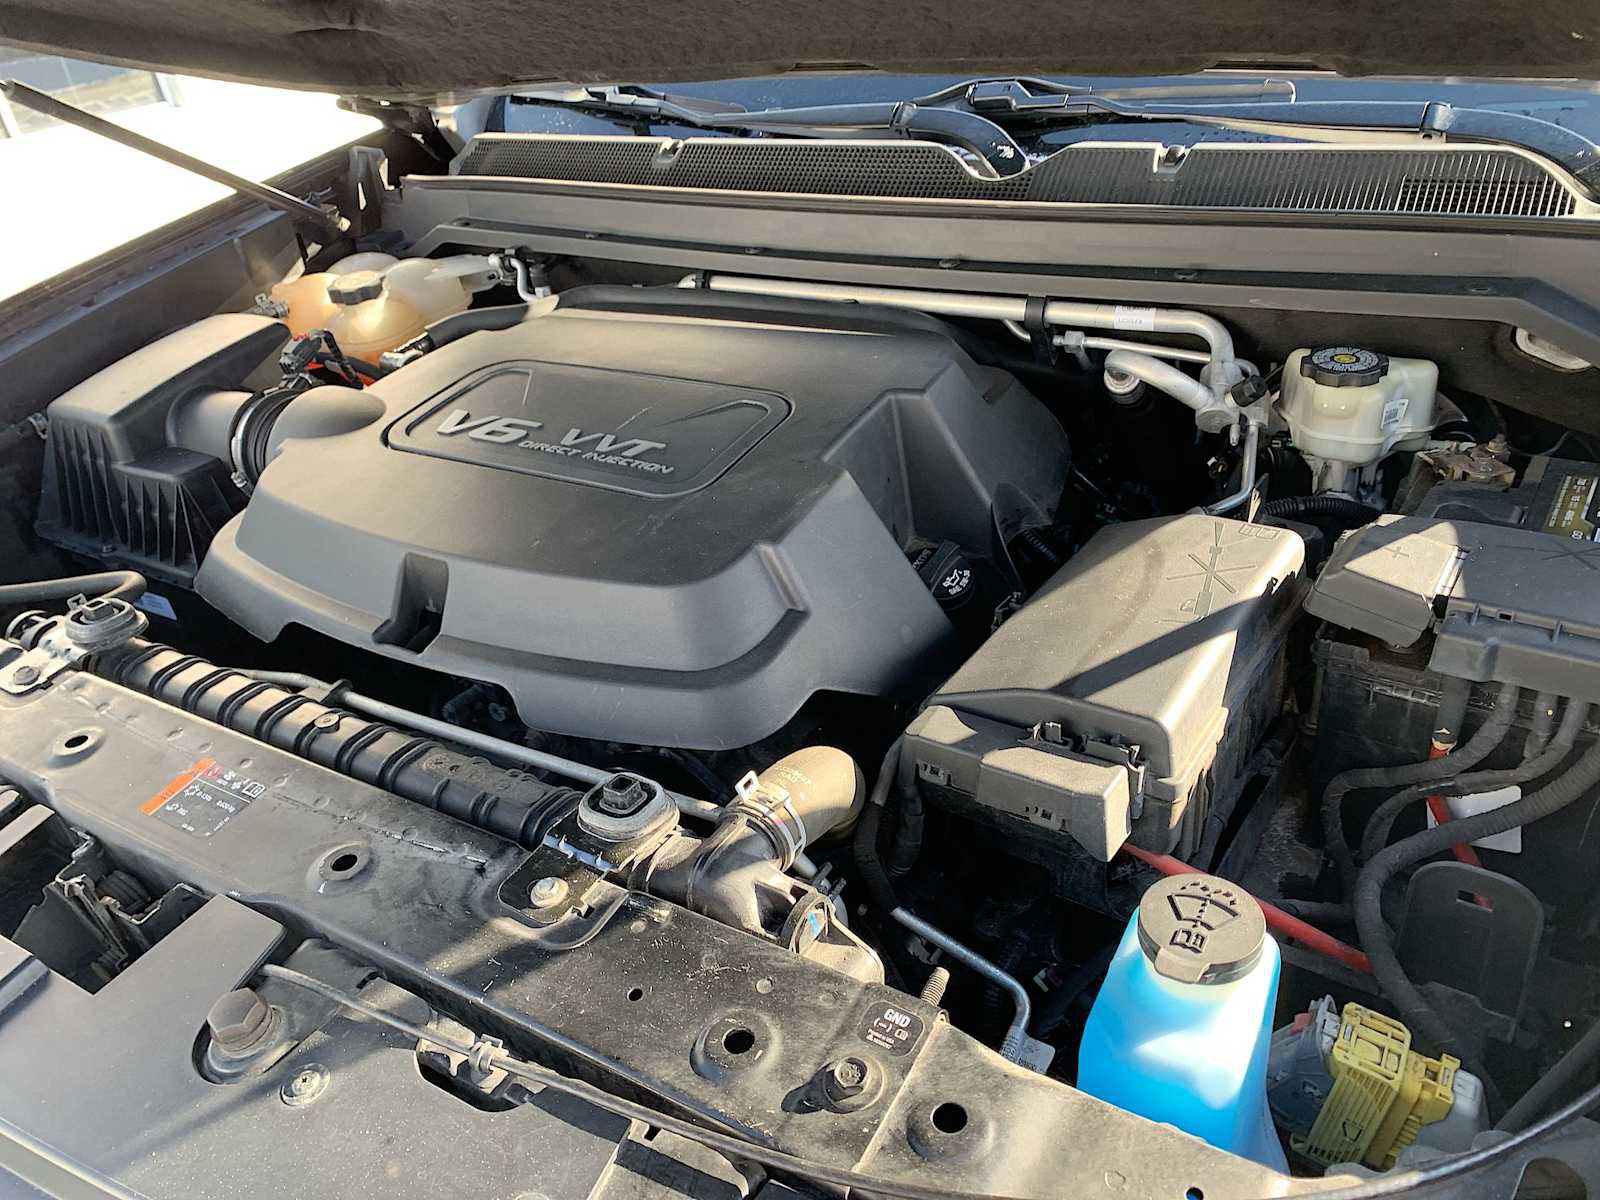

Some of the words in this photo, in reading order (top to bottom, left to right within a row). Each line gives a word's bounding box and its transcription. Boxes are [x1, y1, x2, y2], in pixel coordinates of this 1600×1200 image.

[436, 409, 543, 443] V6
[560, 428, 666, 457] VVT
[518, 440, 582, 456] DIRECT
[582, 452, 674, 474] INJECTION
[884, 1008, 911, 1028] GND
